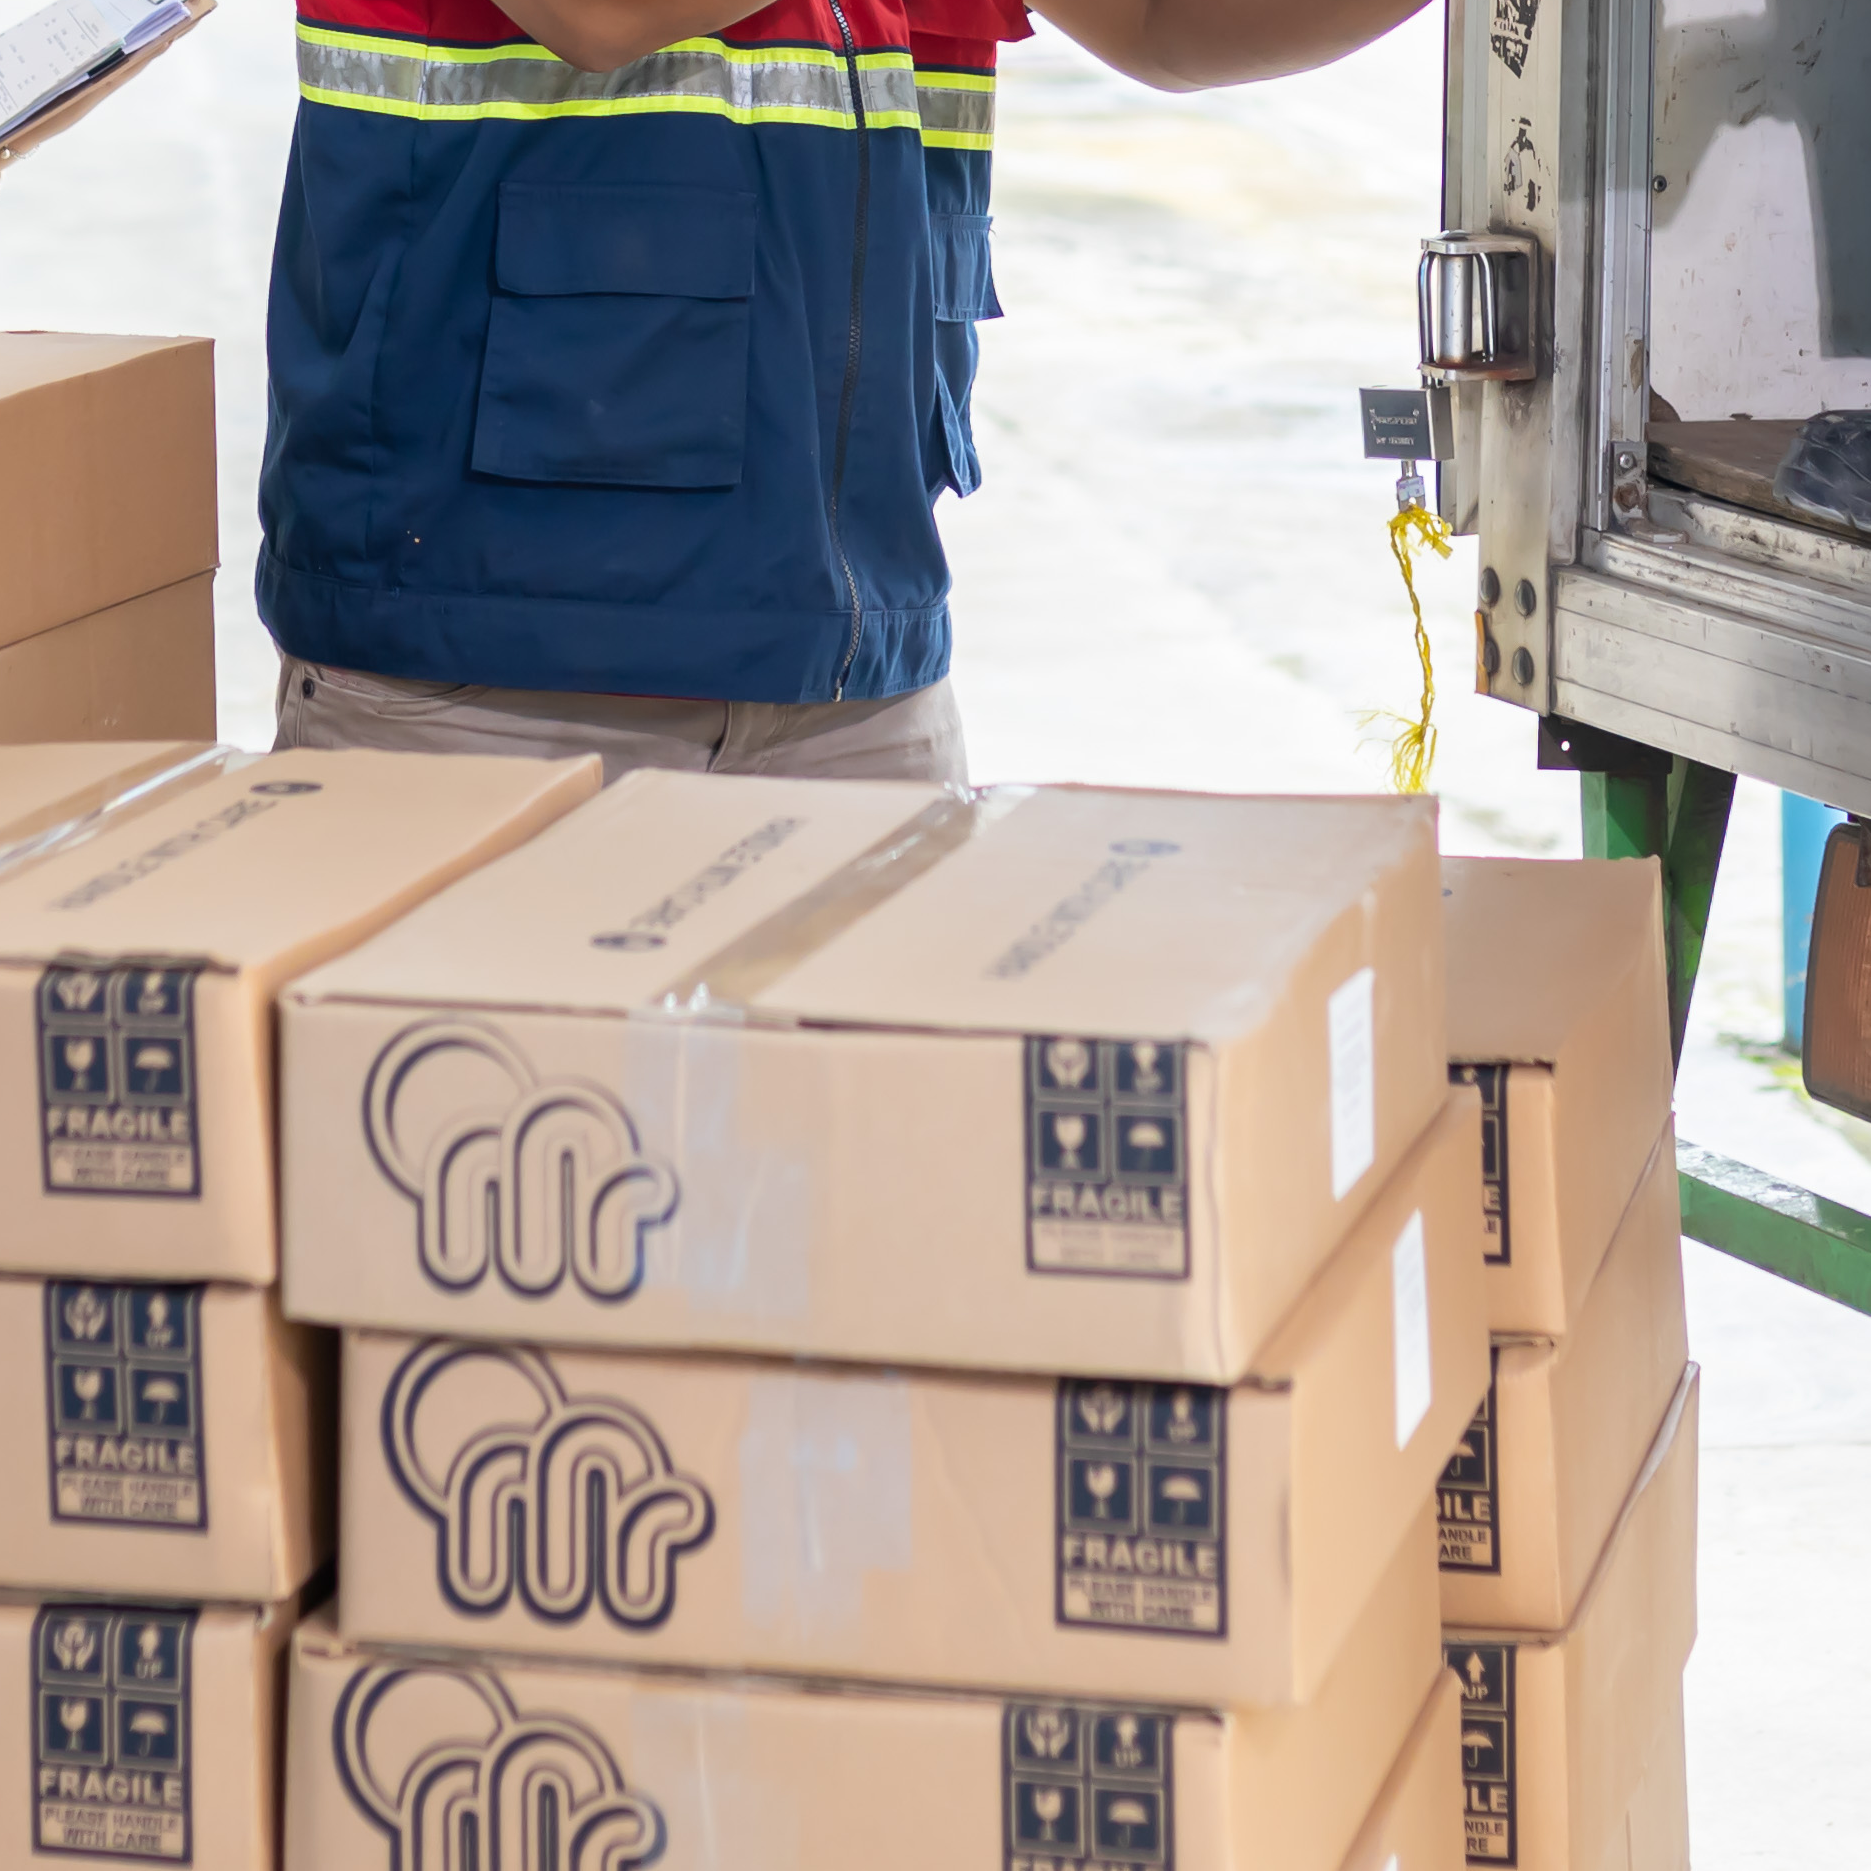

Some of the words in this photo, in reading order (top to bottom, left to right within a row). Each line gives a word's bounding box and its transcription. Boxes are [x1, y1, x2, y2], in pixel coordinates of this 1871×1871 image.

[49, 1107, 190, 1140] FRAGILE
[1032, 1185, 1180, 1222] FRAGILE
[56, 1437, 195, 1475] FRAGILE
[1438, 1527, 1487, 1545] ANDLE
[1064, 1535, 1214, 1577] FRAGILE
[1440, 1544, 1473, 1562] ARE
[1465, 1683, 1489, 1701] UP
[40, 1770, 181, 1808] FRAGILE
[1465, 1819, 1504, 1837] NDLE
[1466, 1836, 1489, 1854] RE
